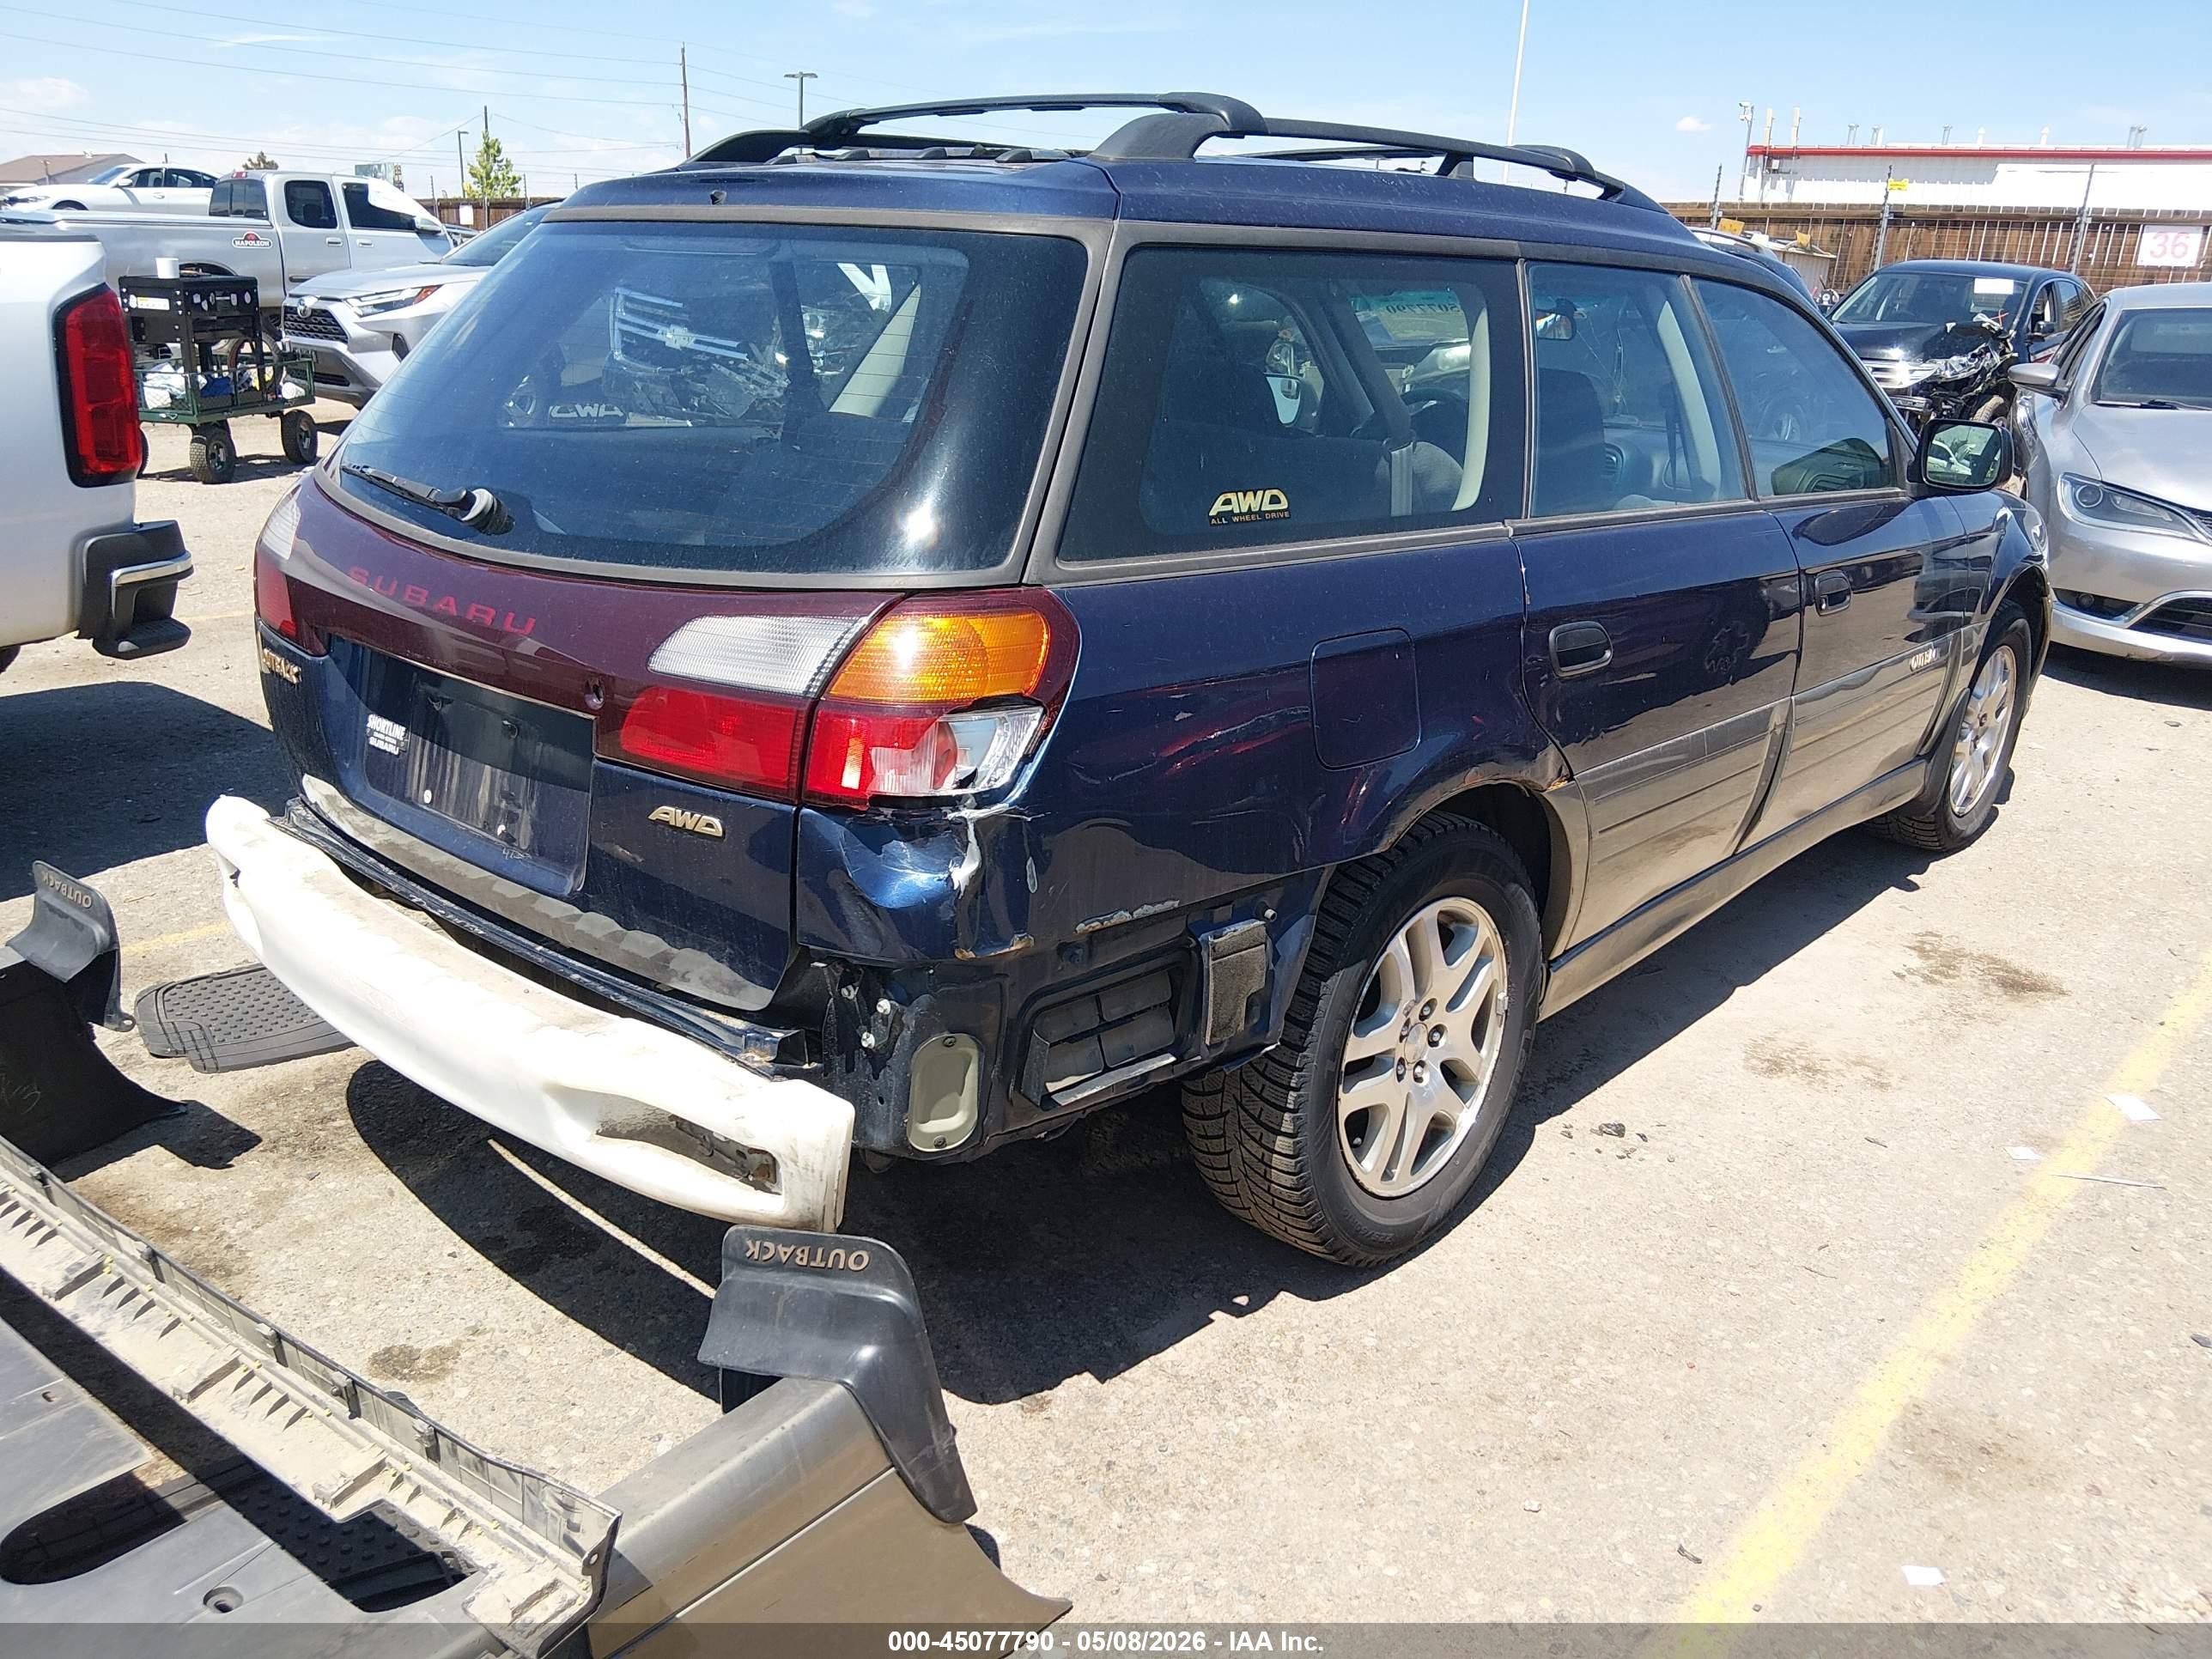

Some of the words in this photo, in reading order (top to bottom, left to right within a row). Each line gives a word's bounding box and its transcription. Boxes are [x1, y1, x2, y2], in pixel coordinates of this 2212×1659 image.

[2149, 231, 2190, 259] 36
[1208, 489, 1289, 515] AWD
[1211, 516, 1228, 525] ALL
[1231, 512, 1262, 522] WHEEL
[1265, 508, 1291, 519] DRIVE
[348, 567, 537, 636] SUBARU
[367, 714, 406, 741] SHORTLINE
[369, 737, 399, 756] SUBARU
[648, 806, 723, 836] AWD
[42, 871, 92, 908] OUTBACK
[745, 1239, 871, 1273] OUTBACK
